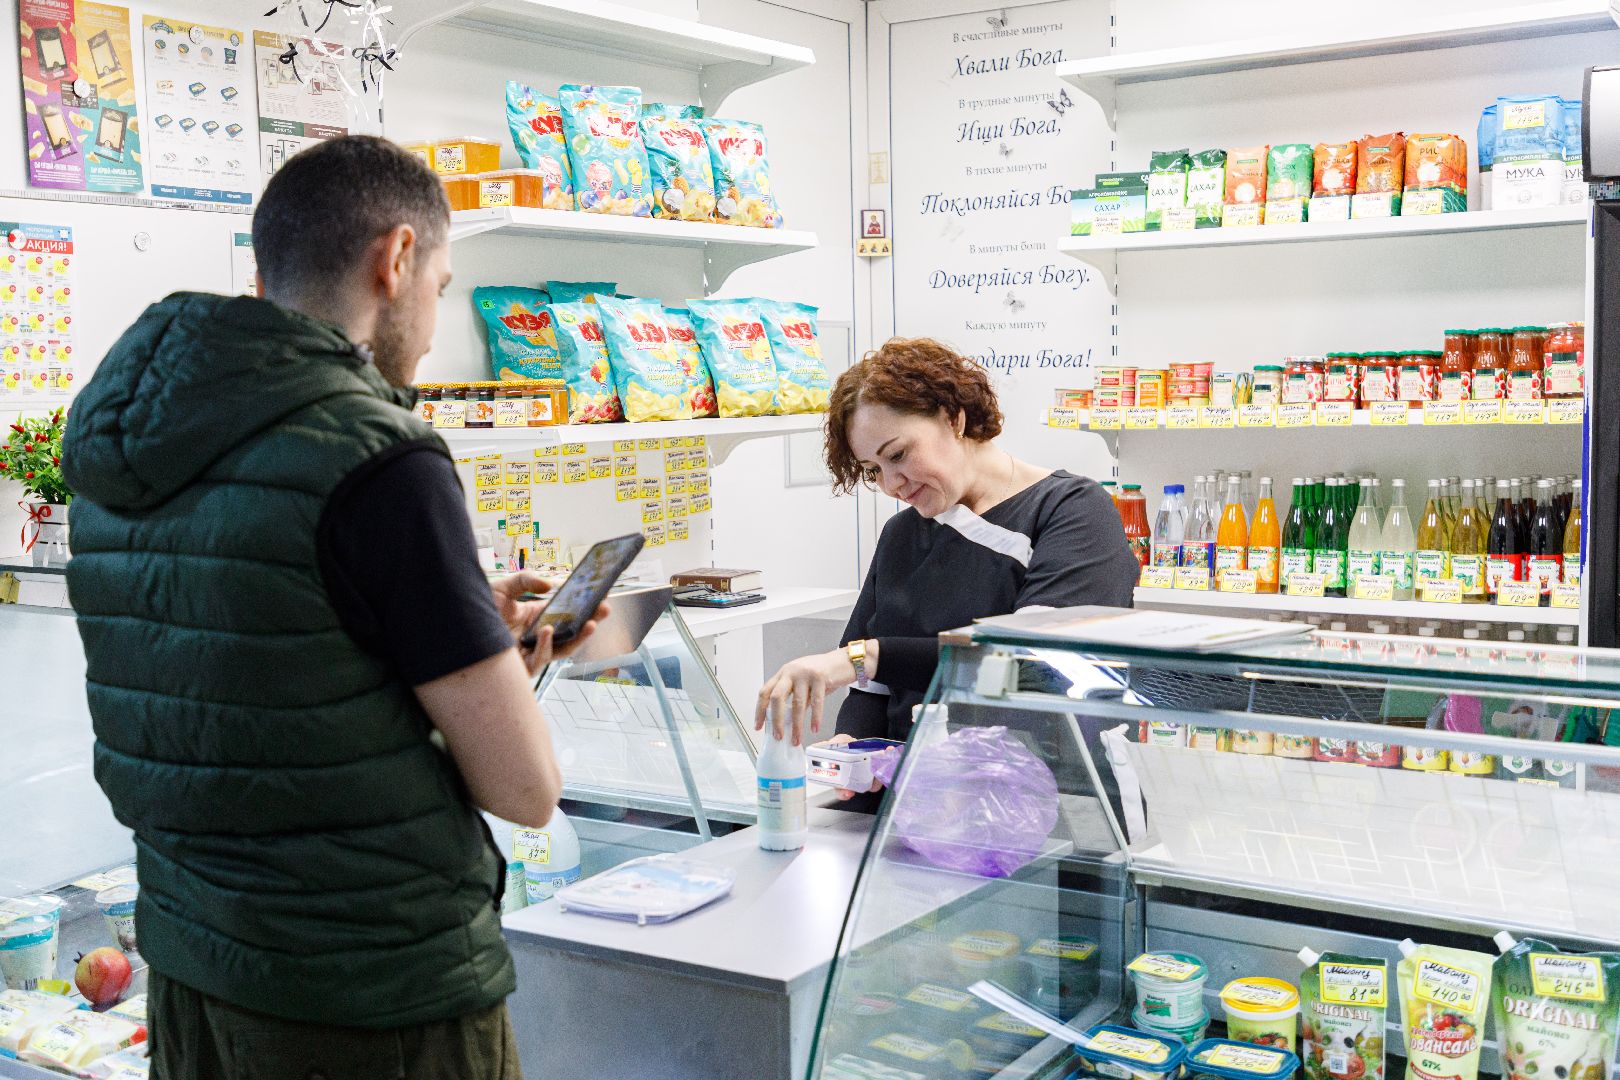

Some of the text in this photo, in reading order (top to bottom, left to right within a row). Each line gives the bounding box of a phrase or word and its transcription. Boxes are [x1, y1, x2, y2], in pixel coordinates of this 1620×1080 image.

[953, 22, 1063, 43] В счастливые минуты
[952, 48, 1067, 76] Хвали Бога.
[958, 92, 1054, 111] В трудные минуты
[957, 117, 1061, 145] Ищи Бога,
[966, 161, 1047, 176] В тихие минуты
[1506, 168, 1545, 179] МУКА
[1151, 188, 1179, 197] САХАР
[921, 189, 1040, 216] Поклоняйся
[1094, 204, 1121, 212] САХАР
[26, 239, 67, 253] АКЦИЯ!
[978, 243, 1019, 254] минуты
[1021, 241, 1047, 251] боли
[929, 264, 1091, 294] Доверяйся Богу.
[499, 311, 551, 331] КУЗЯ
[965, 320, 1048, 332] Каждую минуту
[1036, 348, 1092, 368] Бога!
[1326, 966, 1371, 979] Майонез
[1424, 962, 1471, 985] Майонез
[1350, 987, 1367, 1000] 81
[1554, 979, 1582, 994] 246
[1432, 987, 1458, 1003] 140
[1311, 1001, 1372, 1022] ORIGINAL
[1503, 995, 1600, 1030] ORIGINAL
[1527, 1025, 1570, 1039] майонез
[1422, 1059, 1441, 1072] 67%
